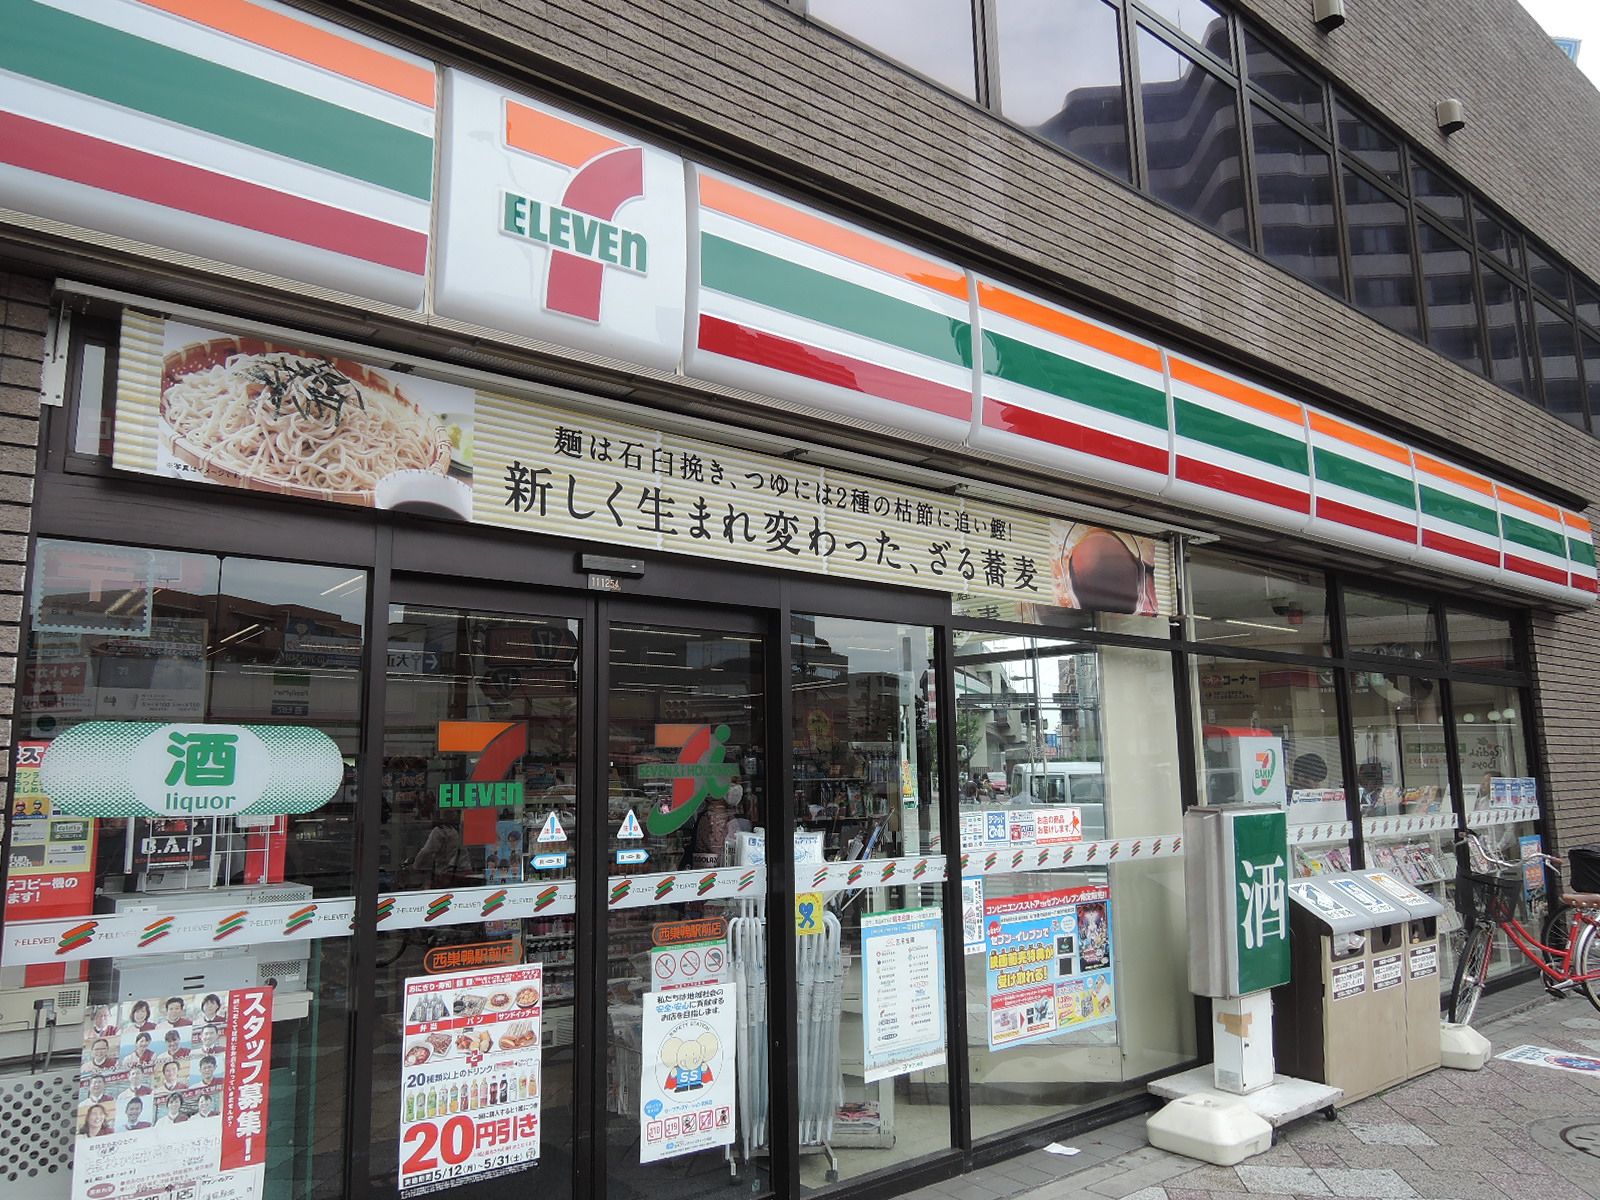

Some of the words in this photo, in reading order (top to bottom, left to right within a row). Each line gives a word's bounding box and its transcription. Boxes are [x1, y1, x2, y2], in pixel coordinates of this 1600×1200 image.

[504, 460, 1040, 593] 新しく生まれ変わった、ざる蕎麦
[164, 731, 239, 787] 酒
[165, 791, 236, 813] liquor
[1240, 855, 1285, 949] 酒
[680, 1070, 698, 1083] SS
[402, 1112, 538, 1176] 20円引き
